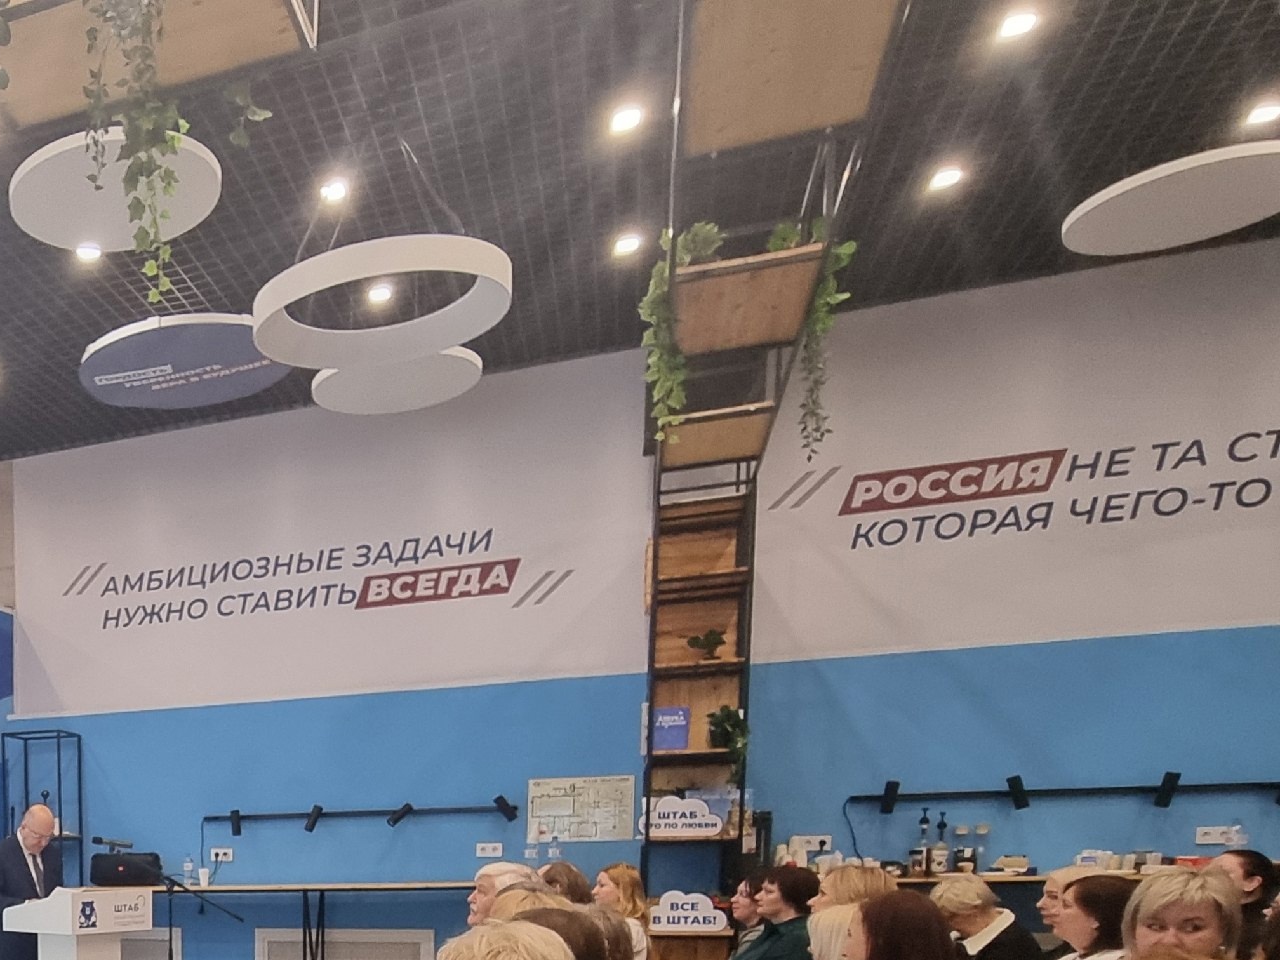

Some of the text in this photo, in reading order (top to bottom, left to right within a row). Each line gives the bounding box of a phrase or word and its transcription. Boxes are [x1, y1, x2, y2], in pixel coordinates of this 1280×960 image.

[850, 456, 1054, 508] РОССИЯ
[1066, 446, 1136, 483] НЕ
[1151, 439, 1208, 471] ТА
[851, 478, 1272, 550] КОТОРАЯ ЧЕГО-ТО
[101, 528, 494, 598] АМБИЦИОЗНЫЕ ЗАДАЧИ
[102, 564, 510, 629] НУЖНО СТАВИТЬ ВСЕГДА
[658, 811, 698, 820] ШТАБ
[681, 822, 718, 830] ЛЮБВИ
[113, 903, 140, 913] ШТАБ
[670, 902, 699, 912] ВСЕ
[652, 916, 717, 925] В ШТАБ!
